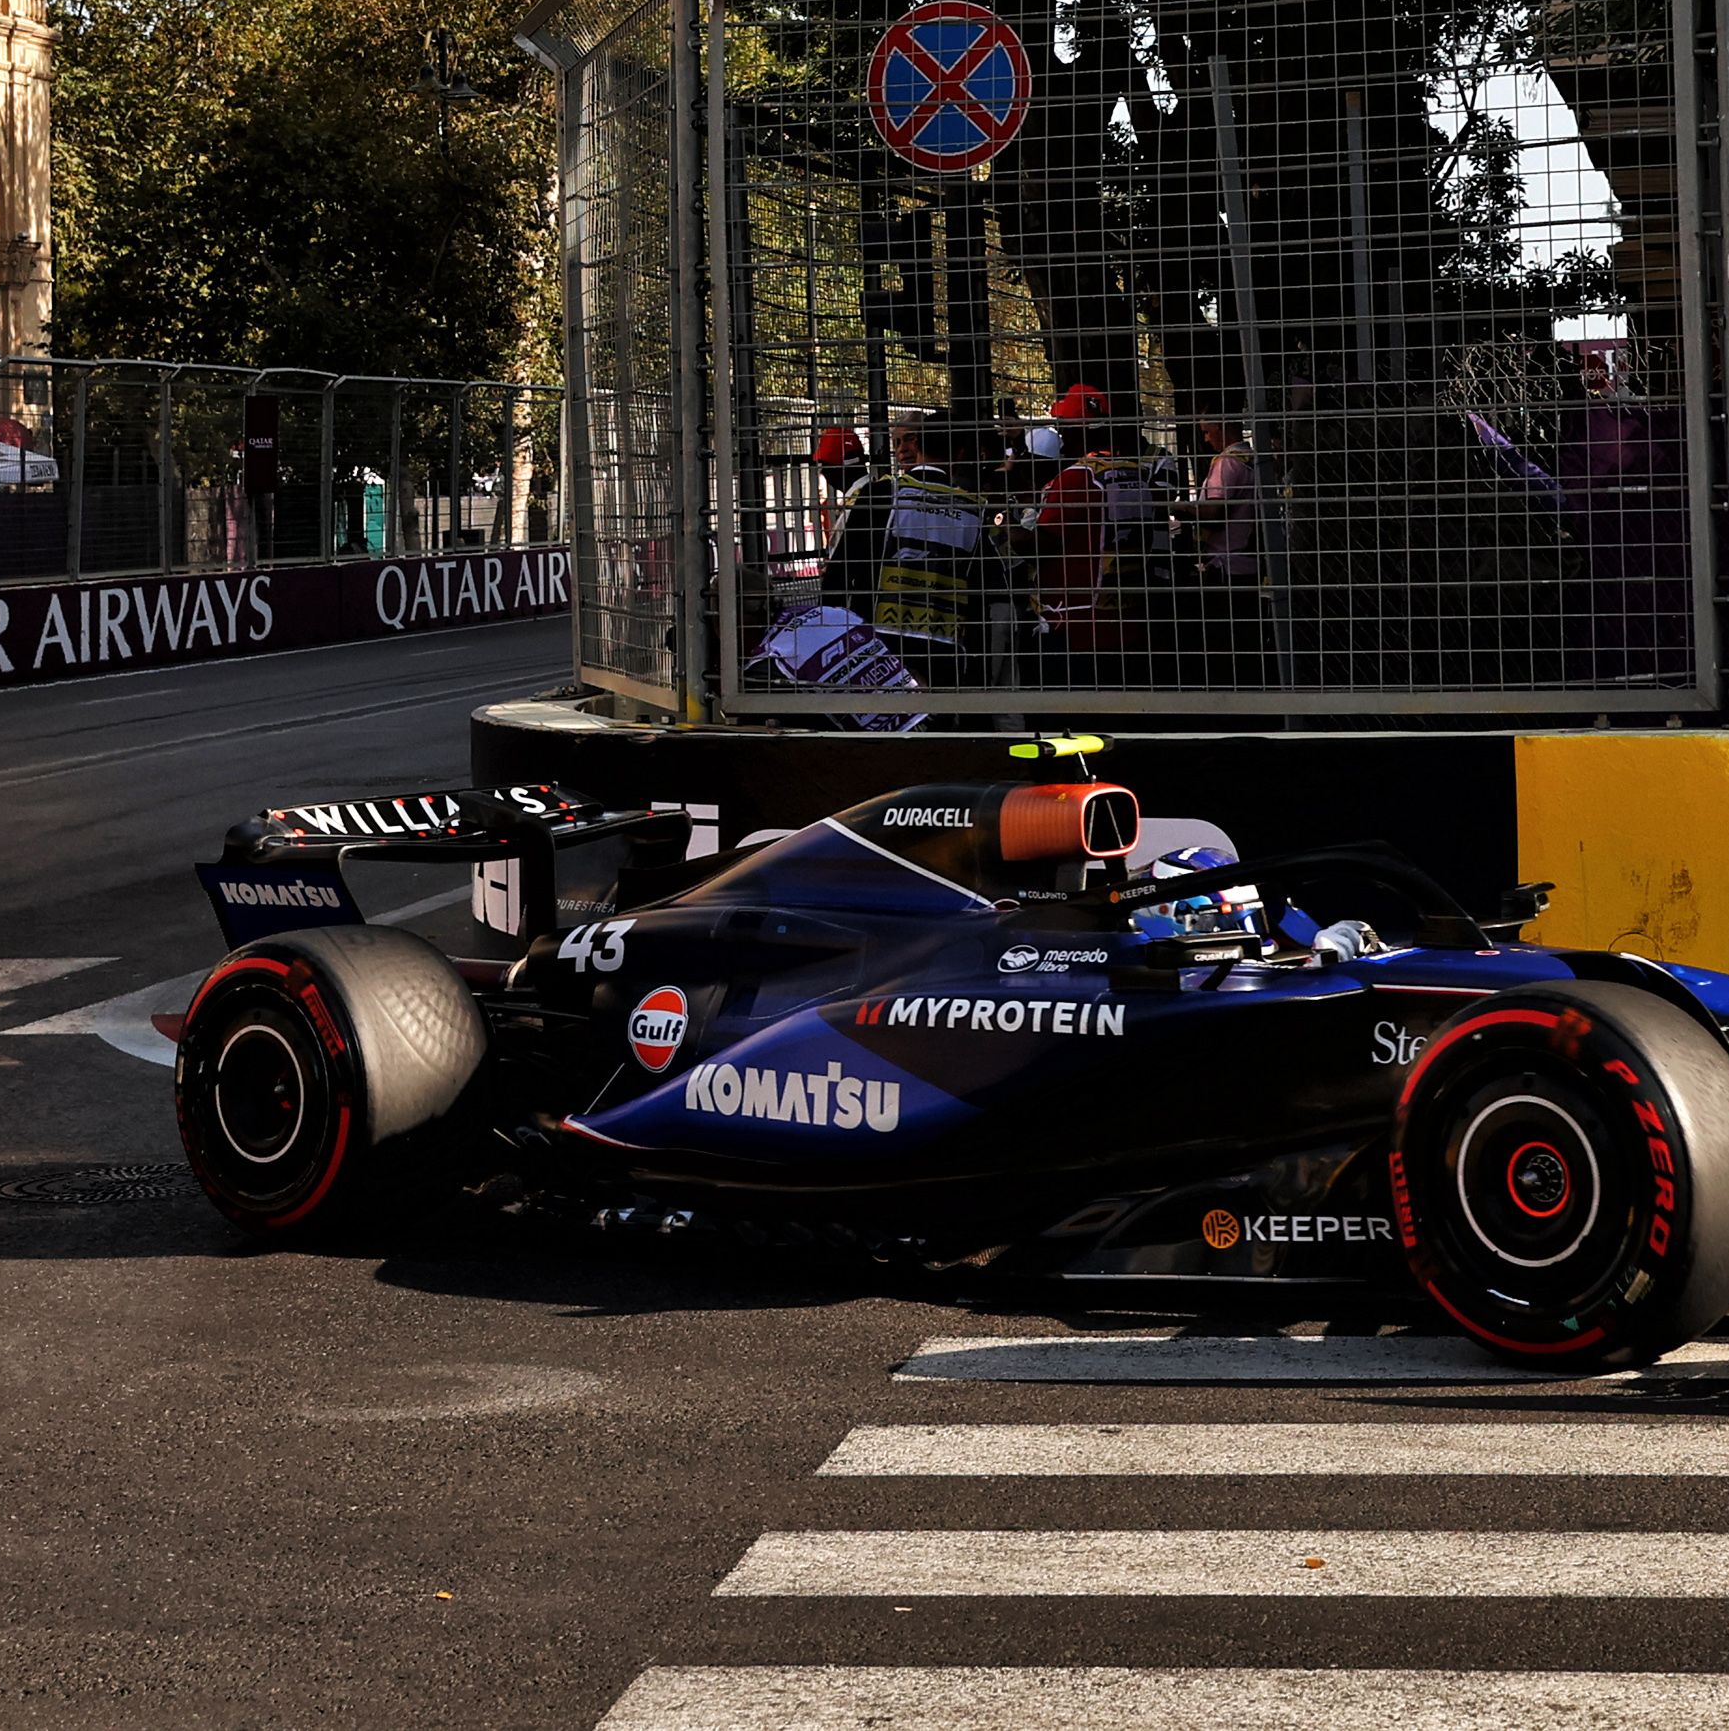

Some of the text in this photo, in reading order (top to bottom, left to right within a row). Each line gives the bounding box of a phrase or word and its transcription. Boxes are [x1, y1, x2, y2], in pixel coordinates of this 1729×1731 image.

[375, 551, 572, 630] QATAR AIR
[32, 574, 273, 669] AIRWAYS
[860, 655, 901, 688] MEDIA
[294, 786, 547, 836] WILLIS
[883, 807, 974, 828] DURACELL
[219, 878, 341, 909] KOMATSU
[555, 898, 617, 915] PURESTREA
[1027, 889, 1068, 901] COLAPINTO
[1119, 884, 1157, 901] KEEPER
[557, 918, 638, 973] 43
[1043, 947, 1109, 964] mercado
[1035, 961, 1071, 973] libre
[631, 1013, 684, 1043] Gulf
[886, 997, 1127, 1037] MYPROTEIN
[1371, 1020, 1429, 1066] Ste
[685, 1060, 901, 1133] KOMATSU
[1603, 1058, 1676, 1258] P ZERO
[1243, 1215, 1394, 1242] KEEPER
